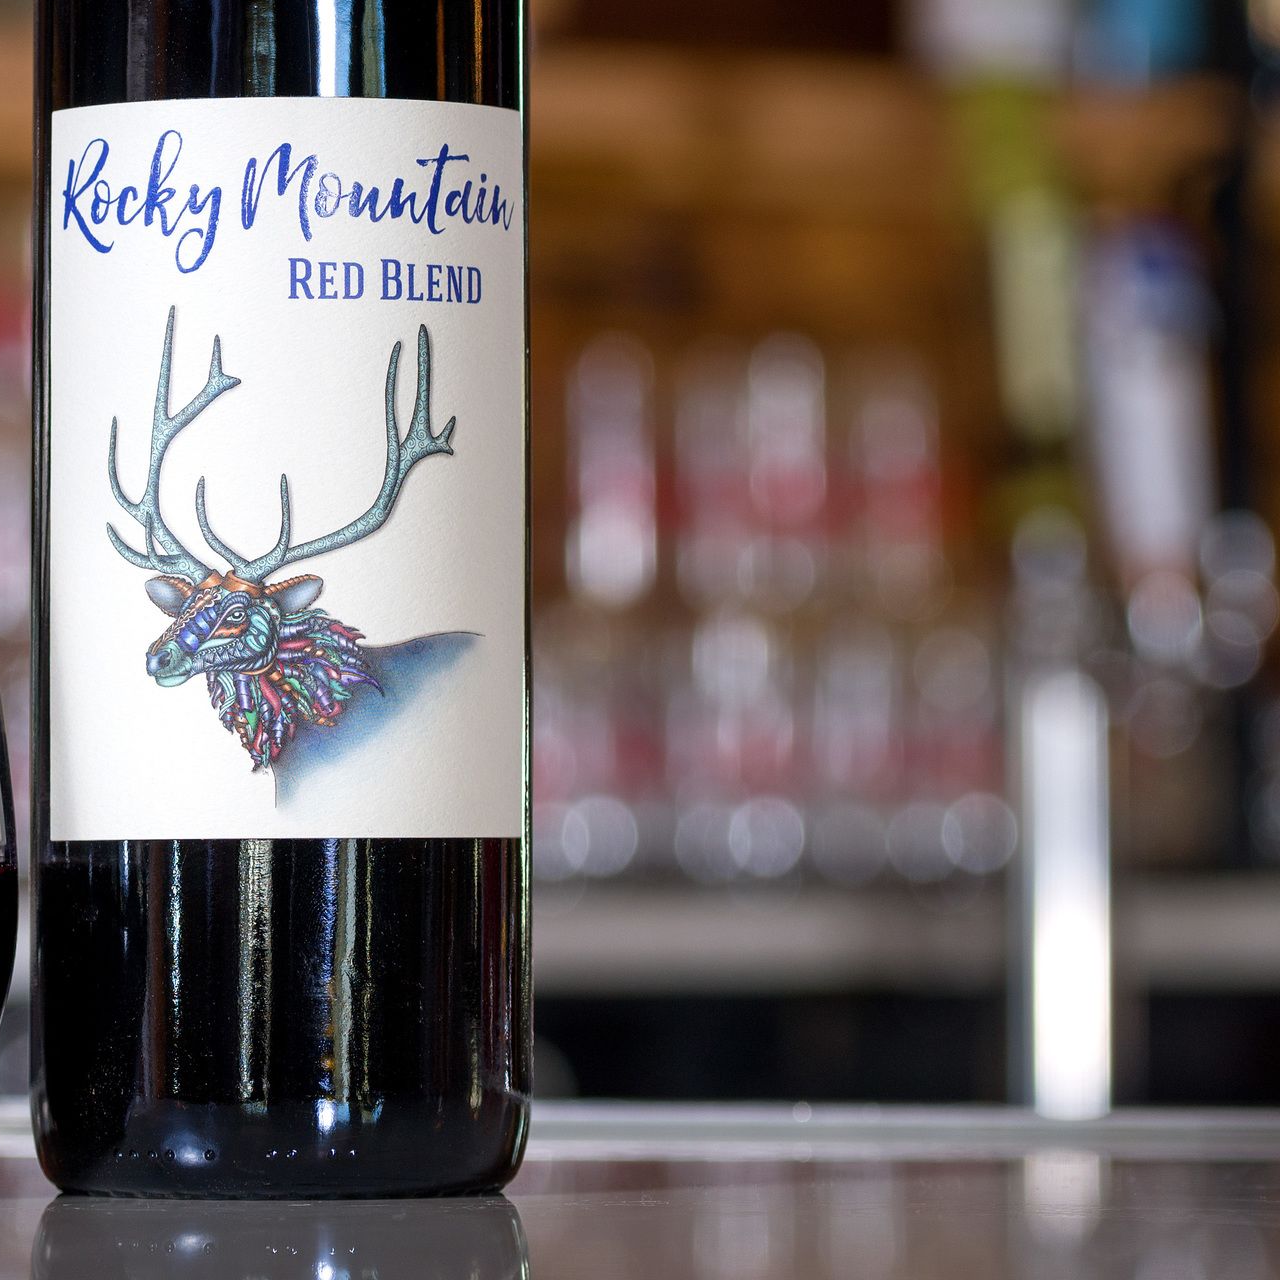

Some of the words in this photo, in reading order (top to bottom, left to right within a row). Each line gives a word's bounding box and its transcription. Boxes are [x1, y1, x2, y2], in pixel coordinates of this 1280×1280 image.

[63, 129, 222, 274] Rocky
[241, 142, 515, 243] Mountain
[287, 257, 365, 301] RED
[379, 258, 483, 305] BLEND
